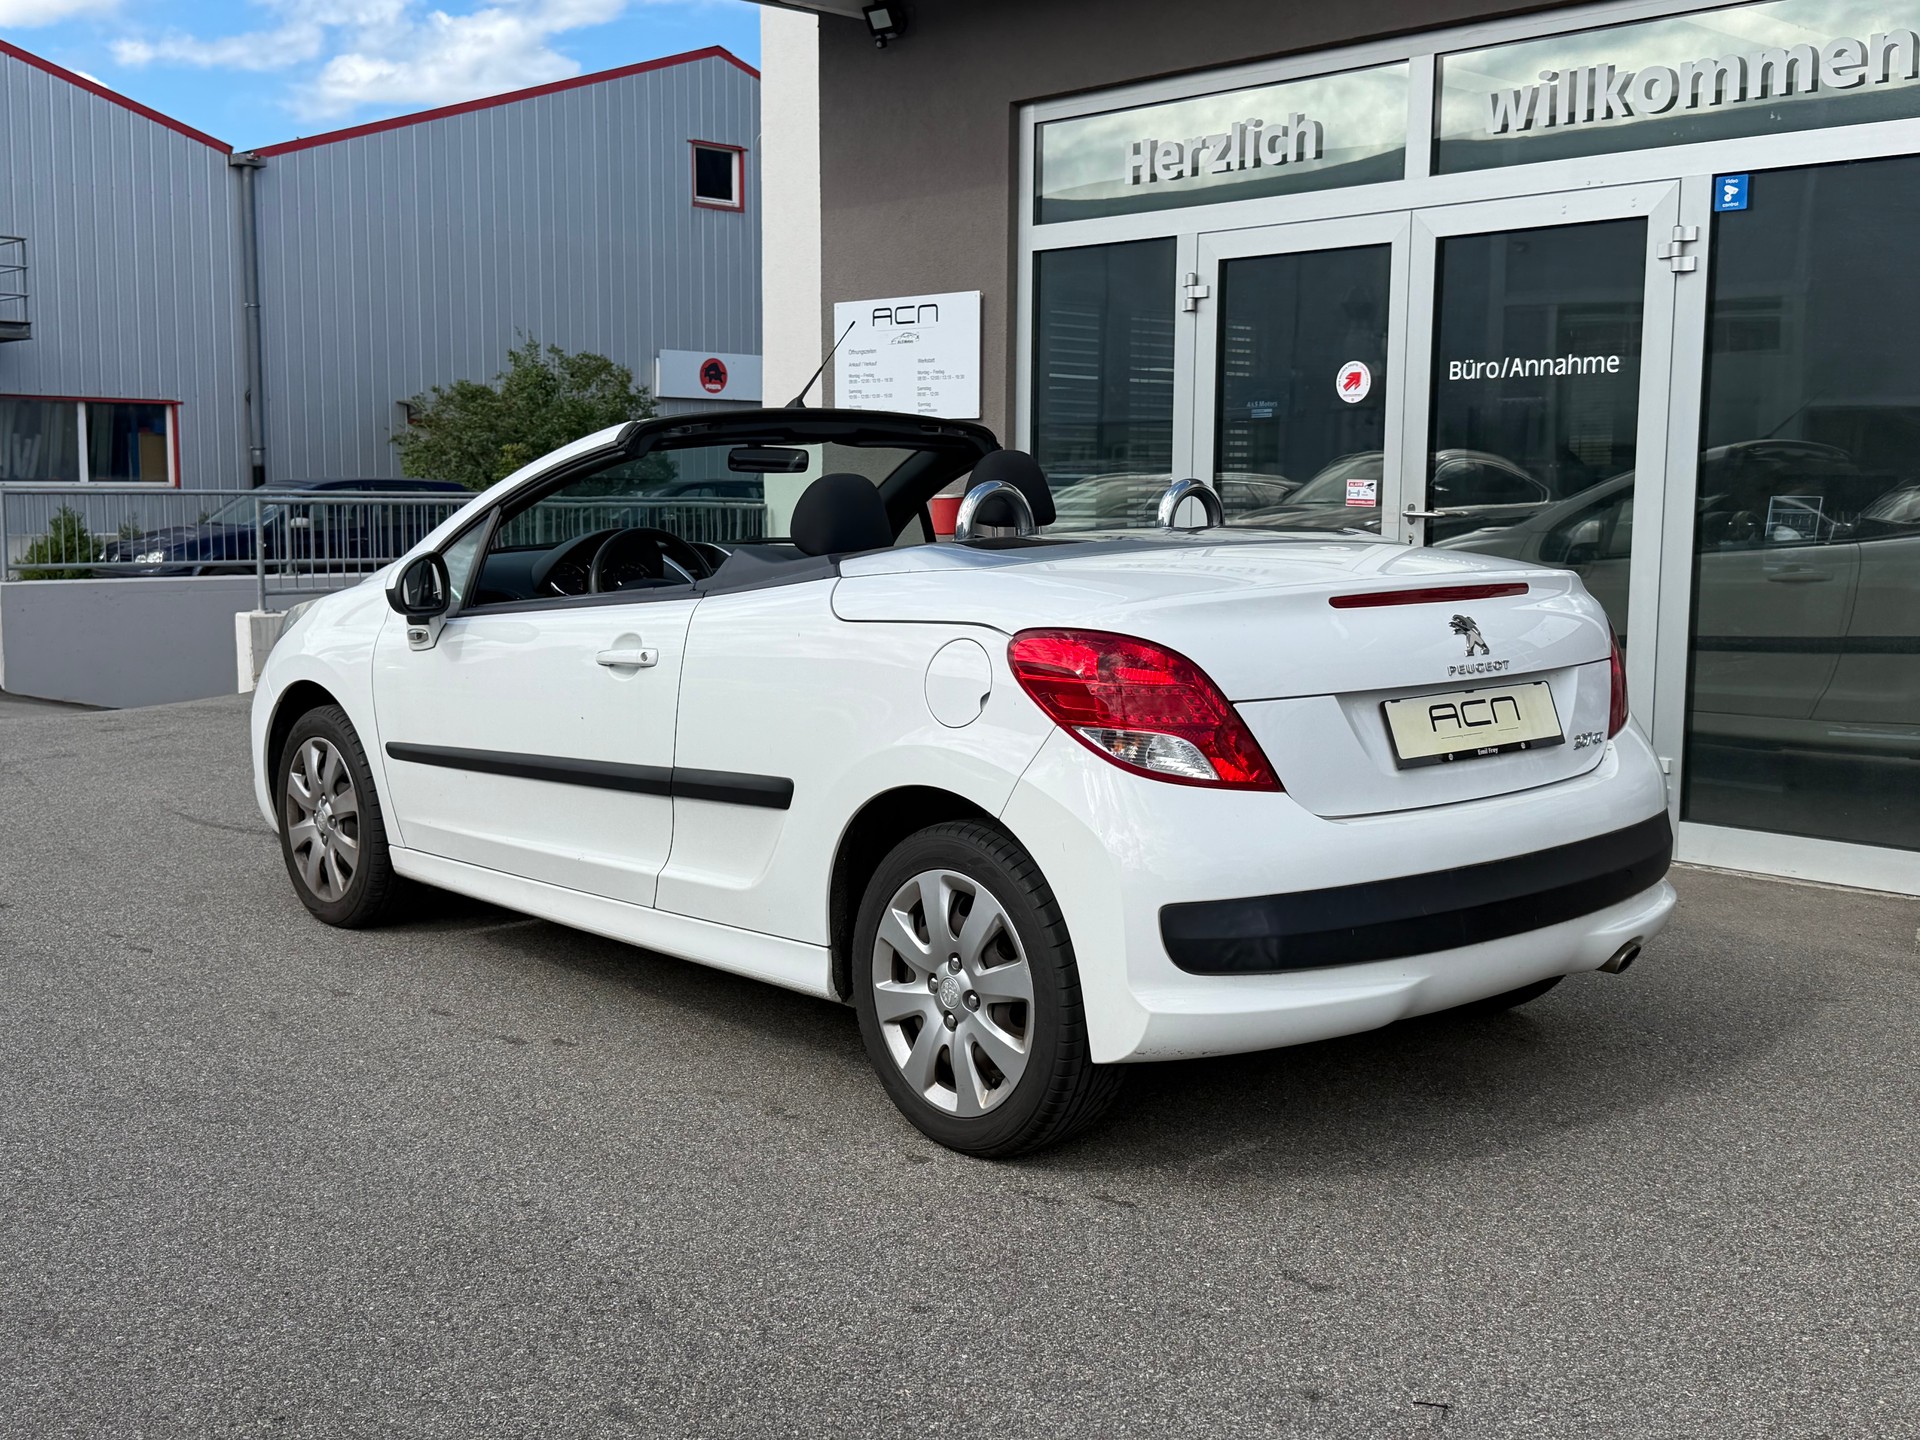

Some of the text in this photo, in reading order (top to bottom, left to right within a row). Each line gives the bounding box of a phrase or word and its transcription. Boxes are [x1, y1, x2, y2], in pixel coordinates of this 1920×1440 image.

[1124, 29, 1920, 185] Herzlich willkommen
[1449, 353, 1620, 381] Büro/Annahme
[1447, 659, 1510, 676] PEUGEOT
